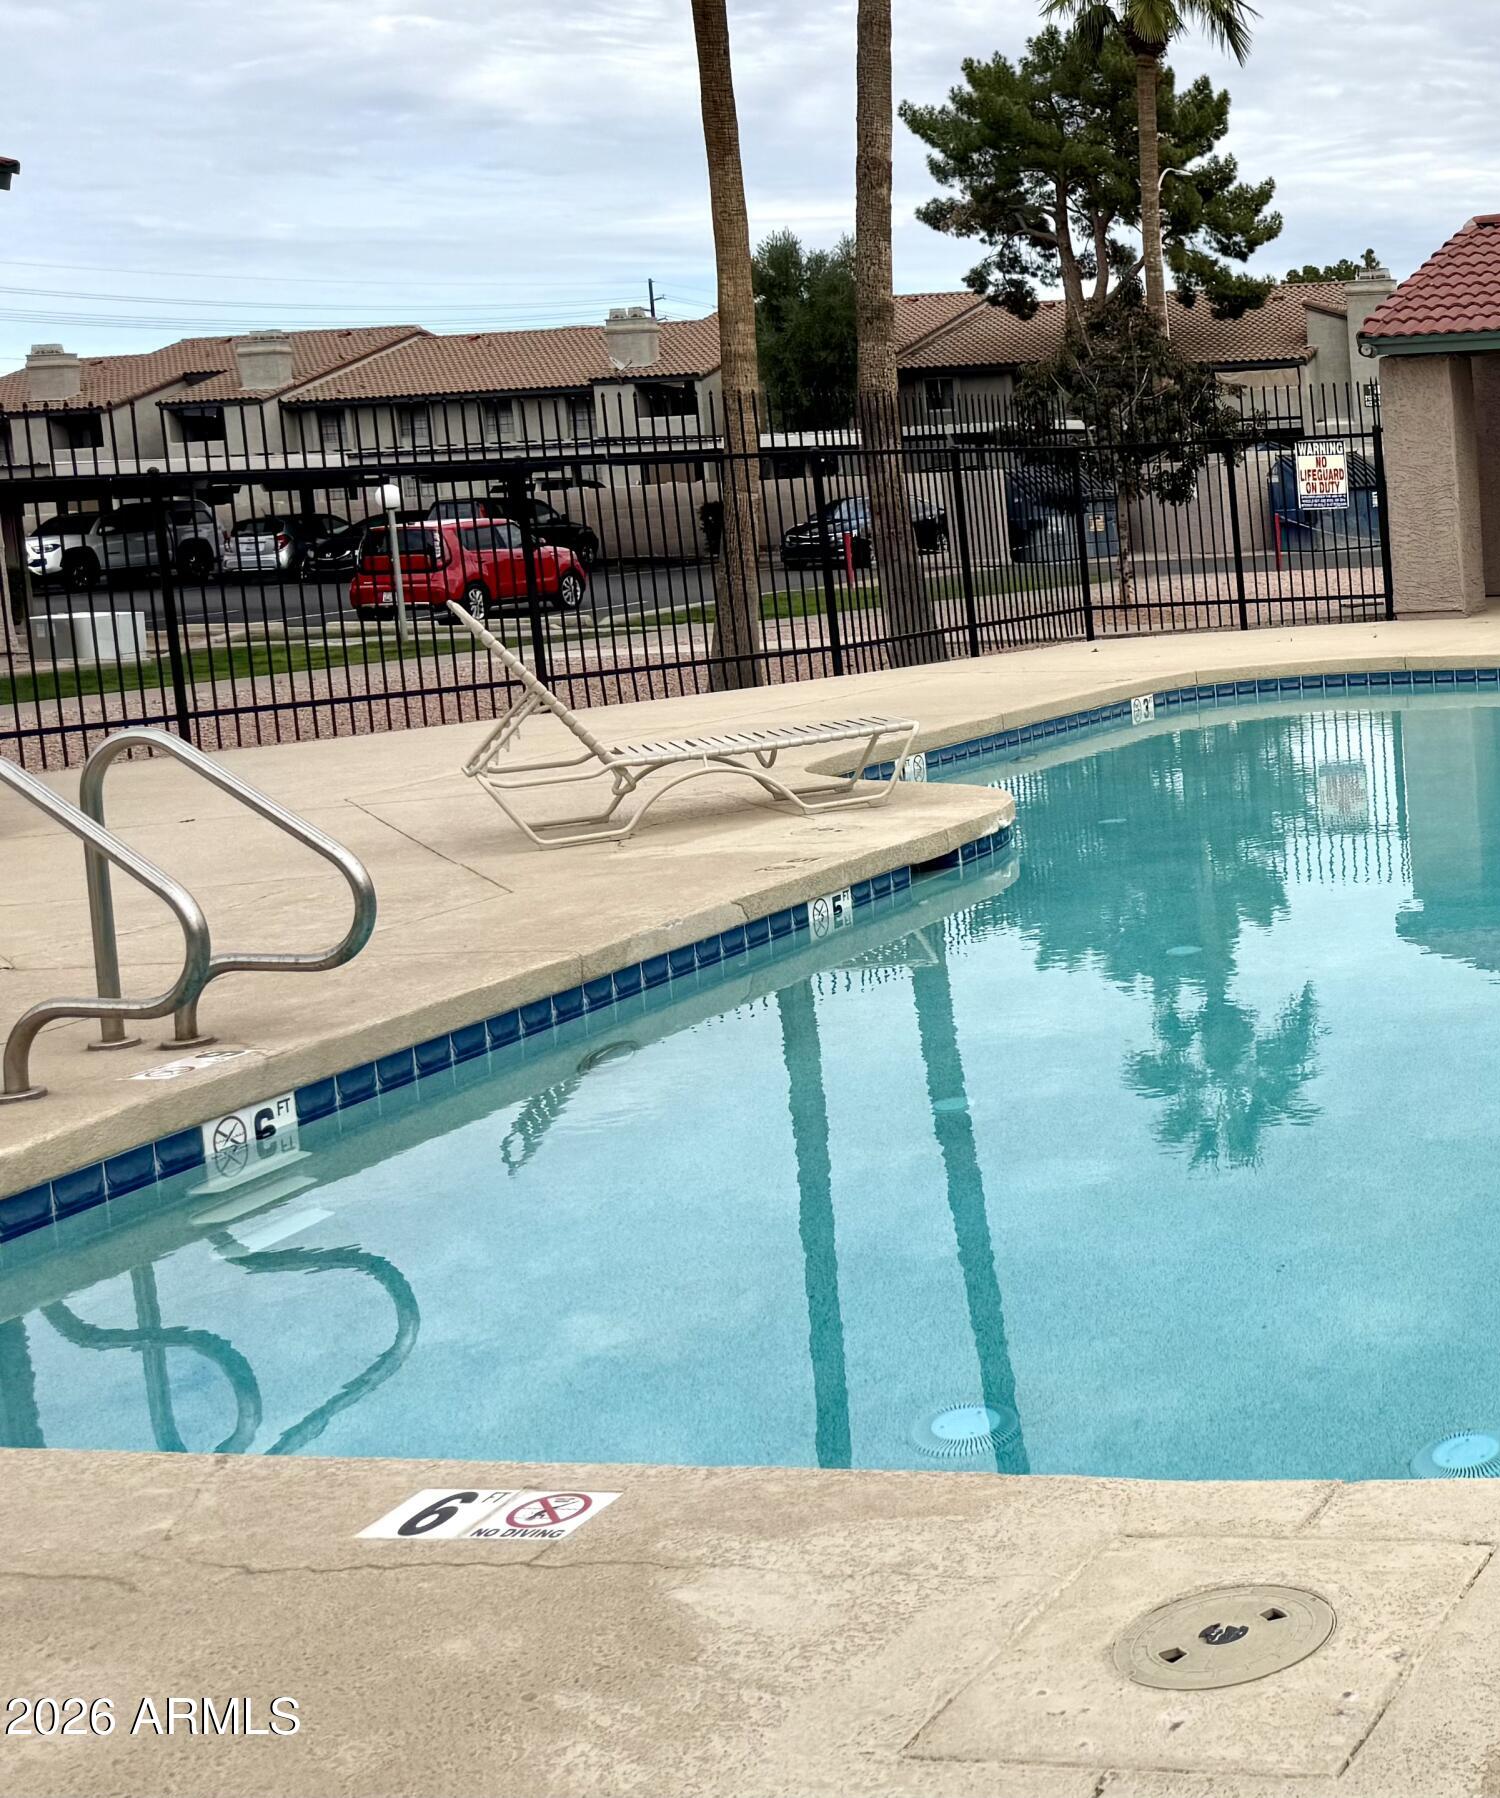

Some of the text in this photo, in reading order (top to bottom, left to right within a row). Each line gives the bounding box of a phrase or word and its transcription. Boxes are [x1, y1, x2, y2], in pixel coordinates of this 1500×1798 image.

[1298, 442, 1343, 455] WARNING
[1315, 456, 1327, 468] NO
[1300, 468, 1344, 481] LIFEGUARD
[1305, 482, 1340, 494] ON DUTY
[277, 1098, 291, 1116] FT
[397, 1491, 511, 1536] 6 FT
[470, 1527, 566, 1539] NO DIVING
